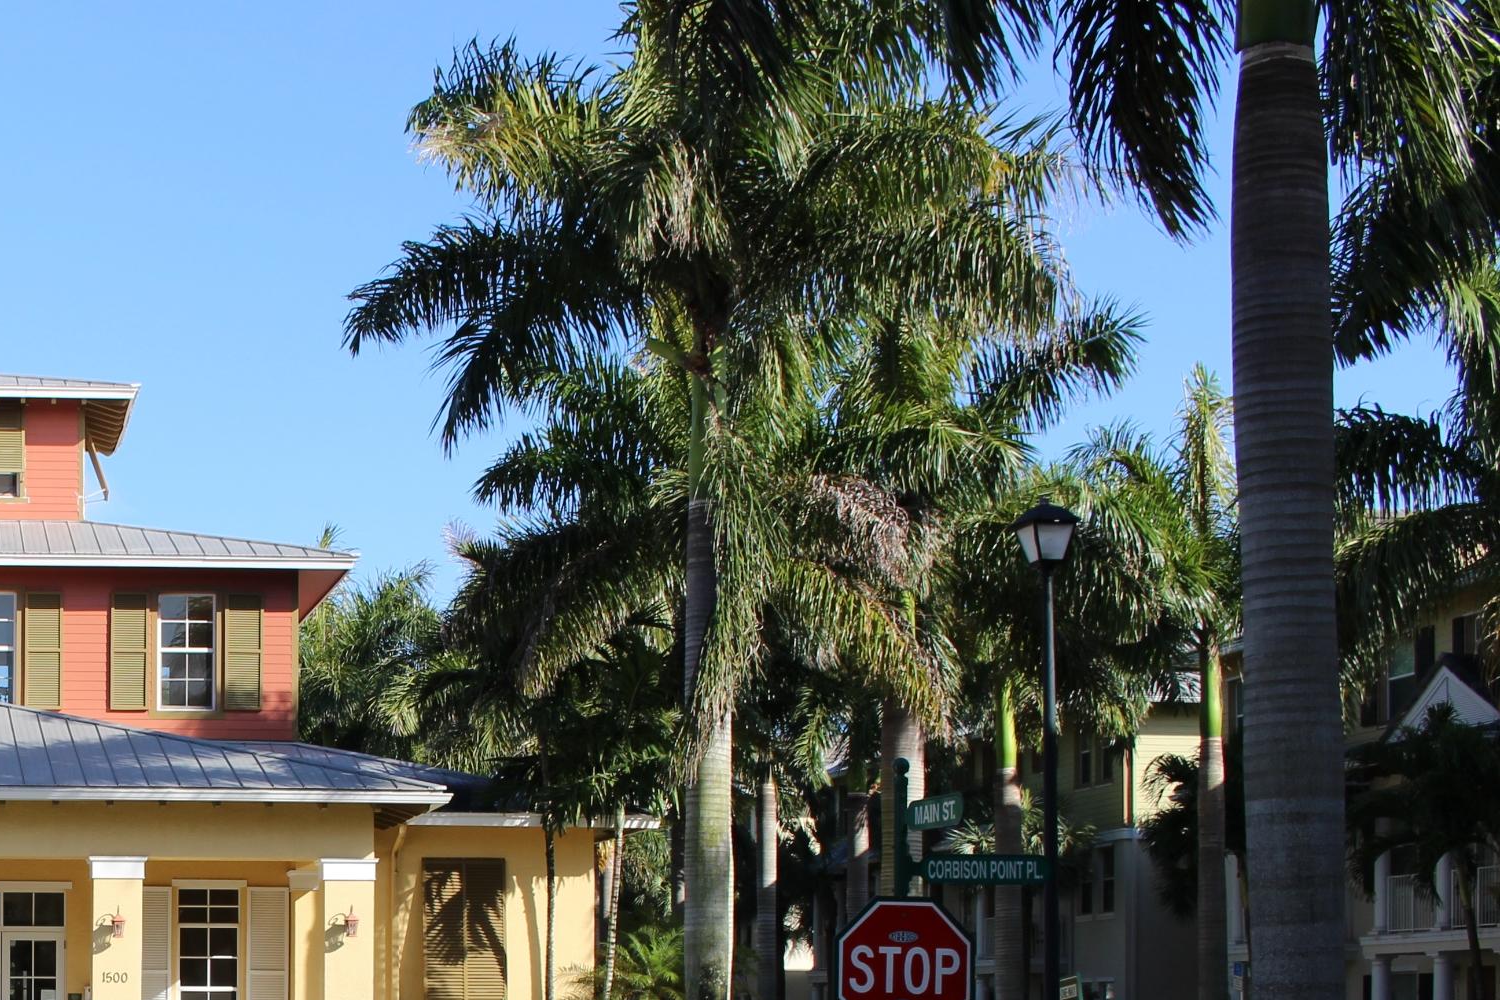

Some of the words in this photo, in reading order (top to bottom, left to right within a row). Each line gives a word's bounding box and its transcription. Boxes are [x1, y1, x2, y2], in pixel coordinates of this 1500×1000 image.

[914, 803, 939, 825] MAIN
[942, 800, 956, 821] ST.
[928, 861, 987, 879] CORBISON
[990, 861, 1023, 879] POINT
[1027, 861, 1043, 879] PL.
[102, 971, 128, 984] 1500
[849, 945, 961, 995] STOP
